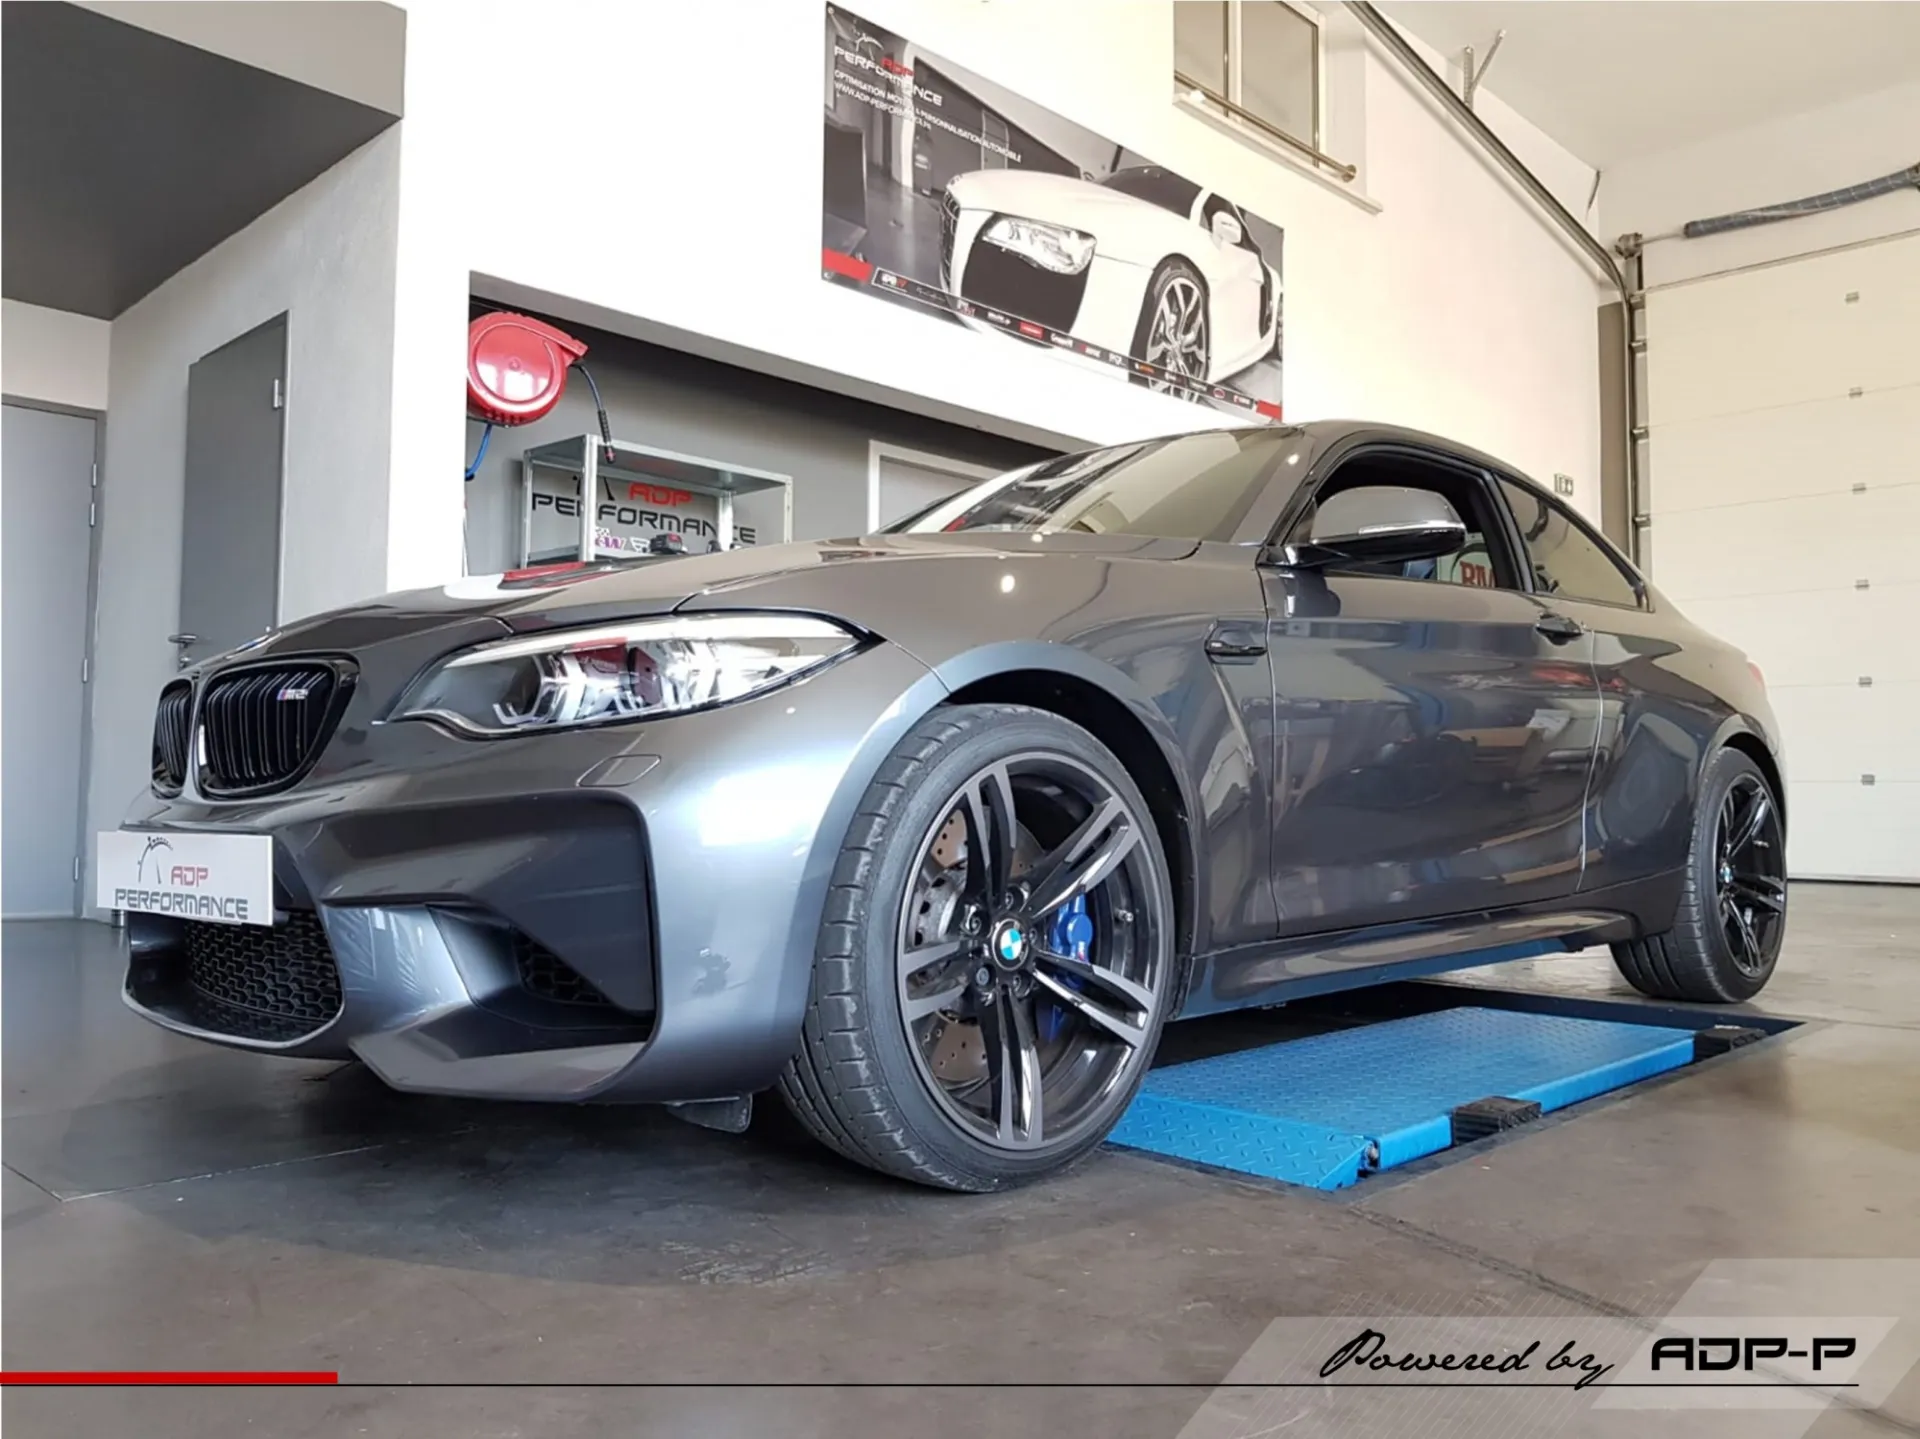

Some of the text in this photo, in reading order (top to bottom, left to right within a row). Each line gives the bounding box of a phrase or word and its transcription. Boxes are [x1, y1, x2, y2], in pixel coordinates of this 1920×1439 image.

[834, 45, 943, 107] PERFORMNCE
[628, 481, 694, 507] ADP
[532, 492, 756, 544] PEFORMANE
[170, 865, 209, 887] ADP
[114, 888, 248, 920] PERFORMANCE
